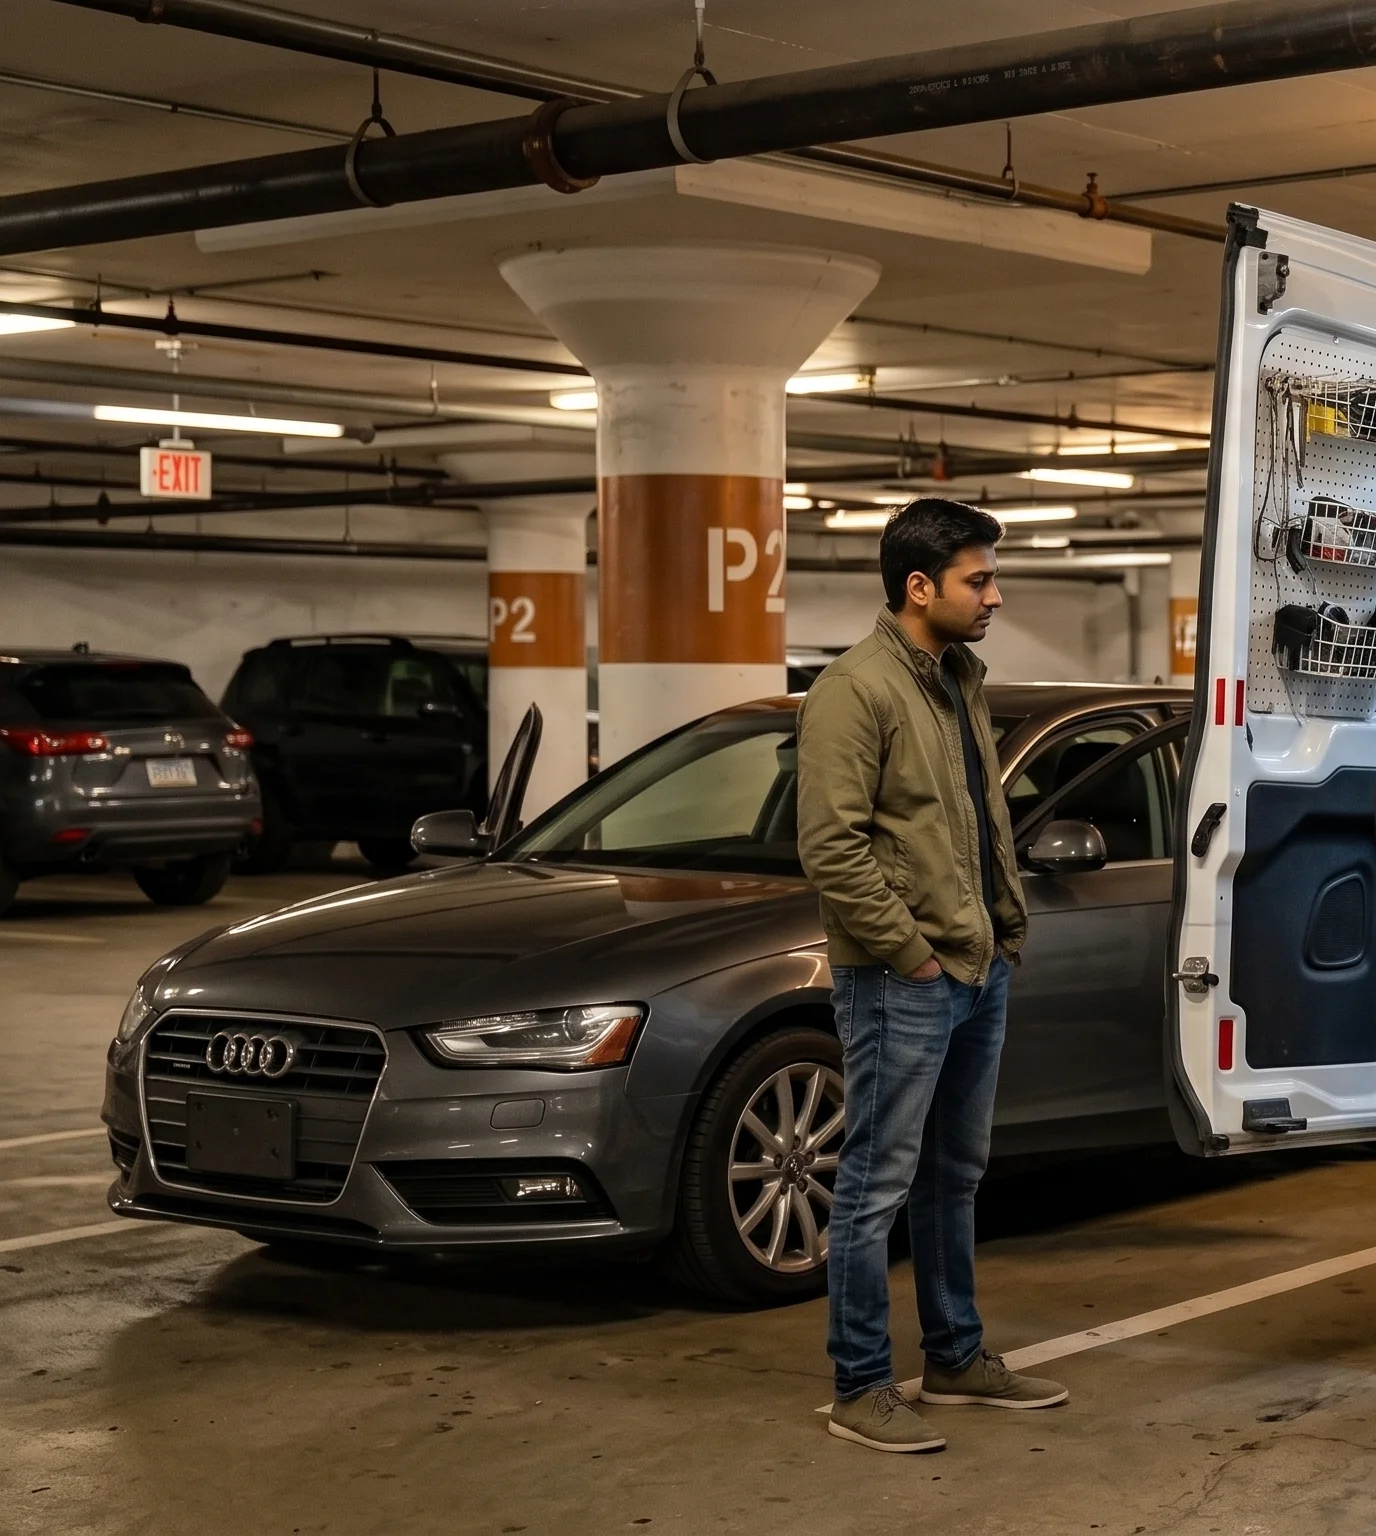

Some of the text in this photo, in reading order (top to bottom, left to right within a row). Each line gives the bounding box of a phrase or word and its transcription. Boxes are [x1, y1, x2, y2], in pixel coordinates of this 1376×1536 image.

[159, 454, 202, 493] EXIT
[707, 526, 785, 613] P2
[490, 596, 536, 643] P2
